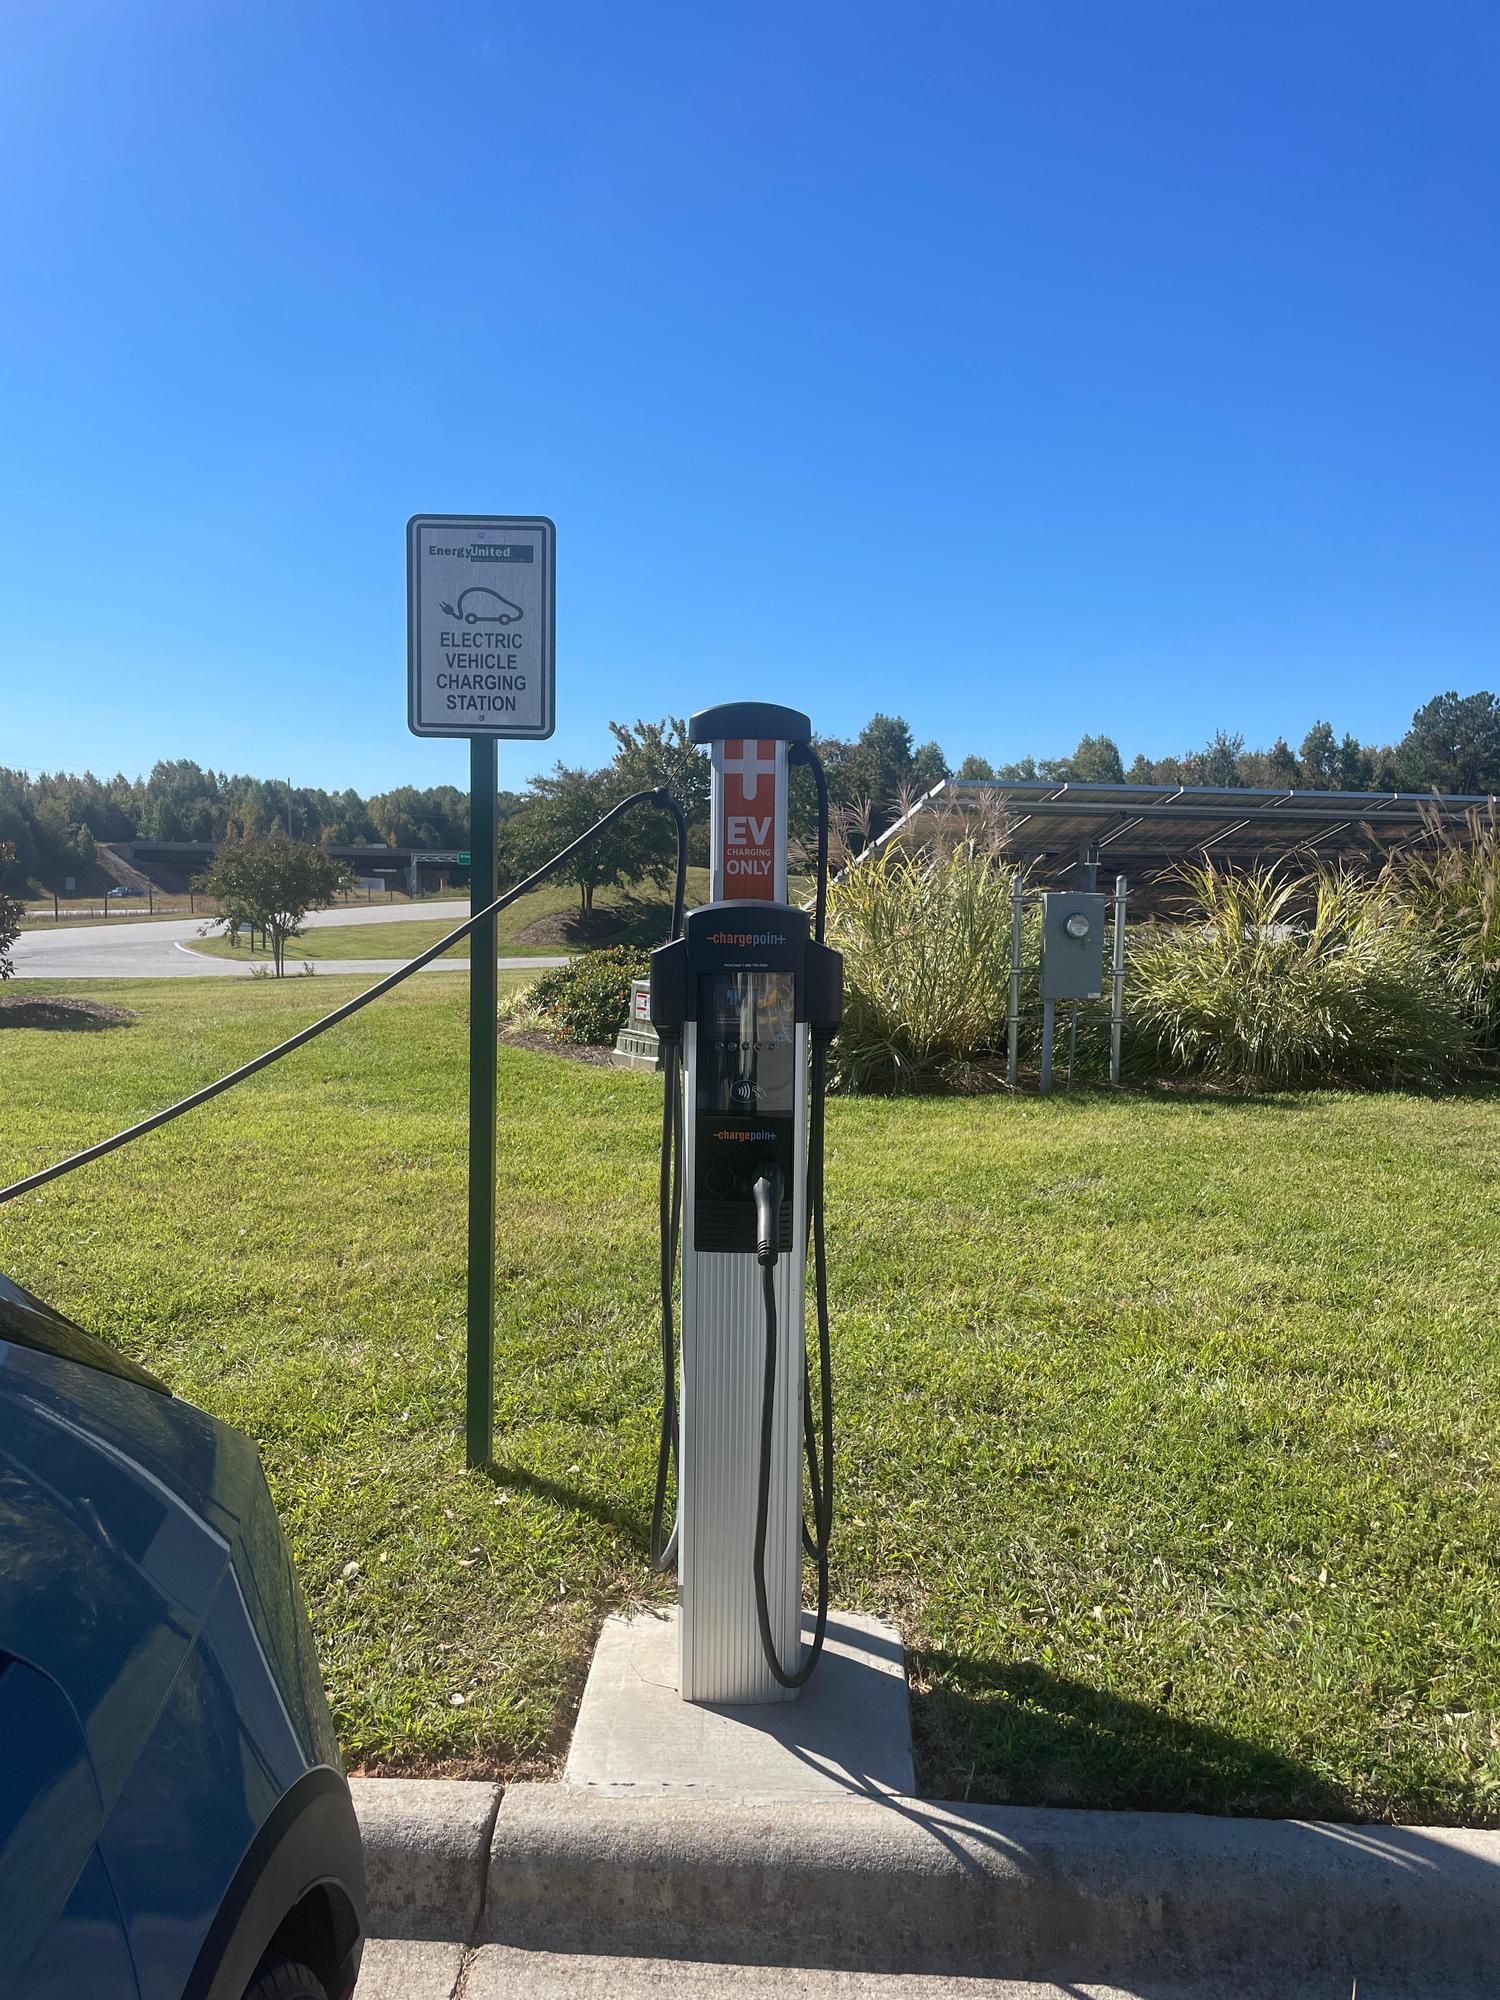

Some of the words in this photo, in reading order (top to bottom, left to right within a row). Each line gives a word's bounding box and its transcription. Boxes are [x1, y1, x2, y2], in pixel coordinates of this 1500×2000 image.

[429, 546, 511, 558] EnergyUnited
[440, 632, 523, 649] ELECTRIC
[445, 653, 517, 670] VEHICLE
[436, 673, 526, 691] CHARGING
[446, 694, 516, 711] STATION
[727, 816, 772, 846] EV
[726, 848, 771, 857] CHARGING
[726, 859, 772, 875] ONLY
